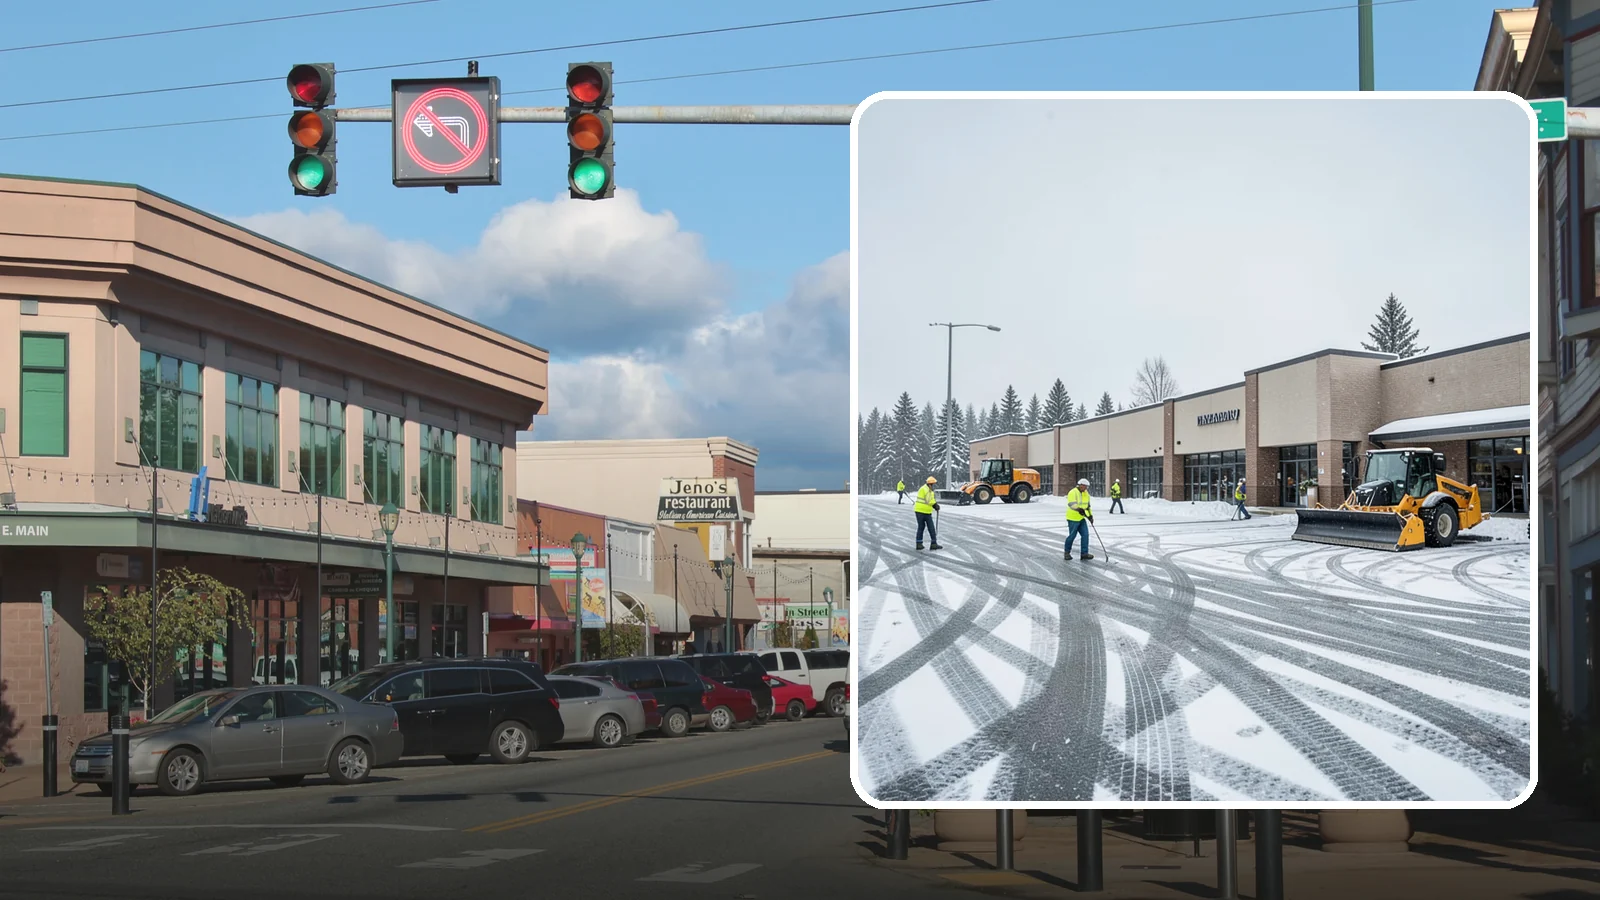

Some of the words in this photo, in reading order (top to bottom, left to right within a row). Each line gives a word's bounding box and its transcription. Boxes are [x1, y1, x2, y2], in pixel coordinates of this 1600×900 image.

[670, 480, 727, 494] Jeno's
[665, 496, 731, 509] restaurant
[658, 510, 681, 519] Italian
[686, 510, 714, 519] American
[715, 510, 737, 519] Cuisine
[2, 525, 13, 536] E.
[15, 525, 49, 536] MAIN
[797, 608, 828, 616] Street
